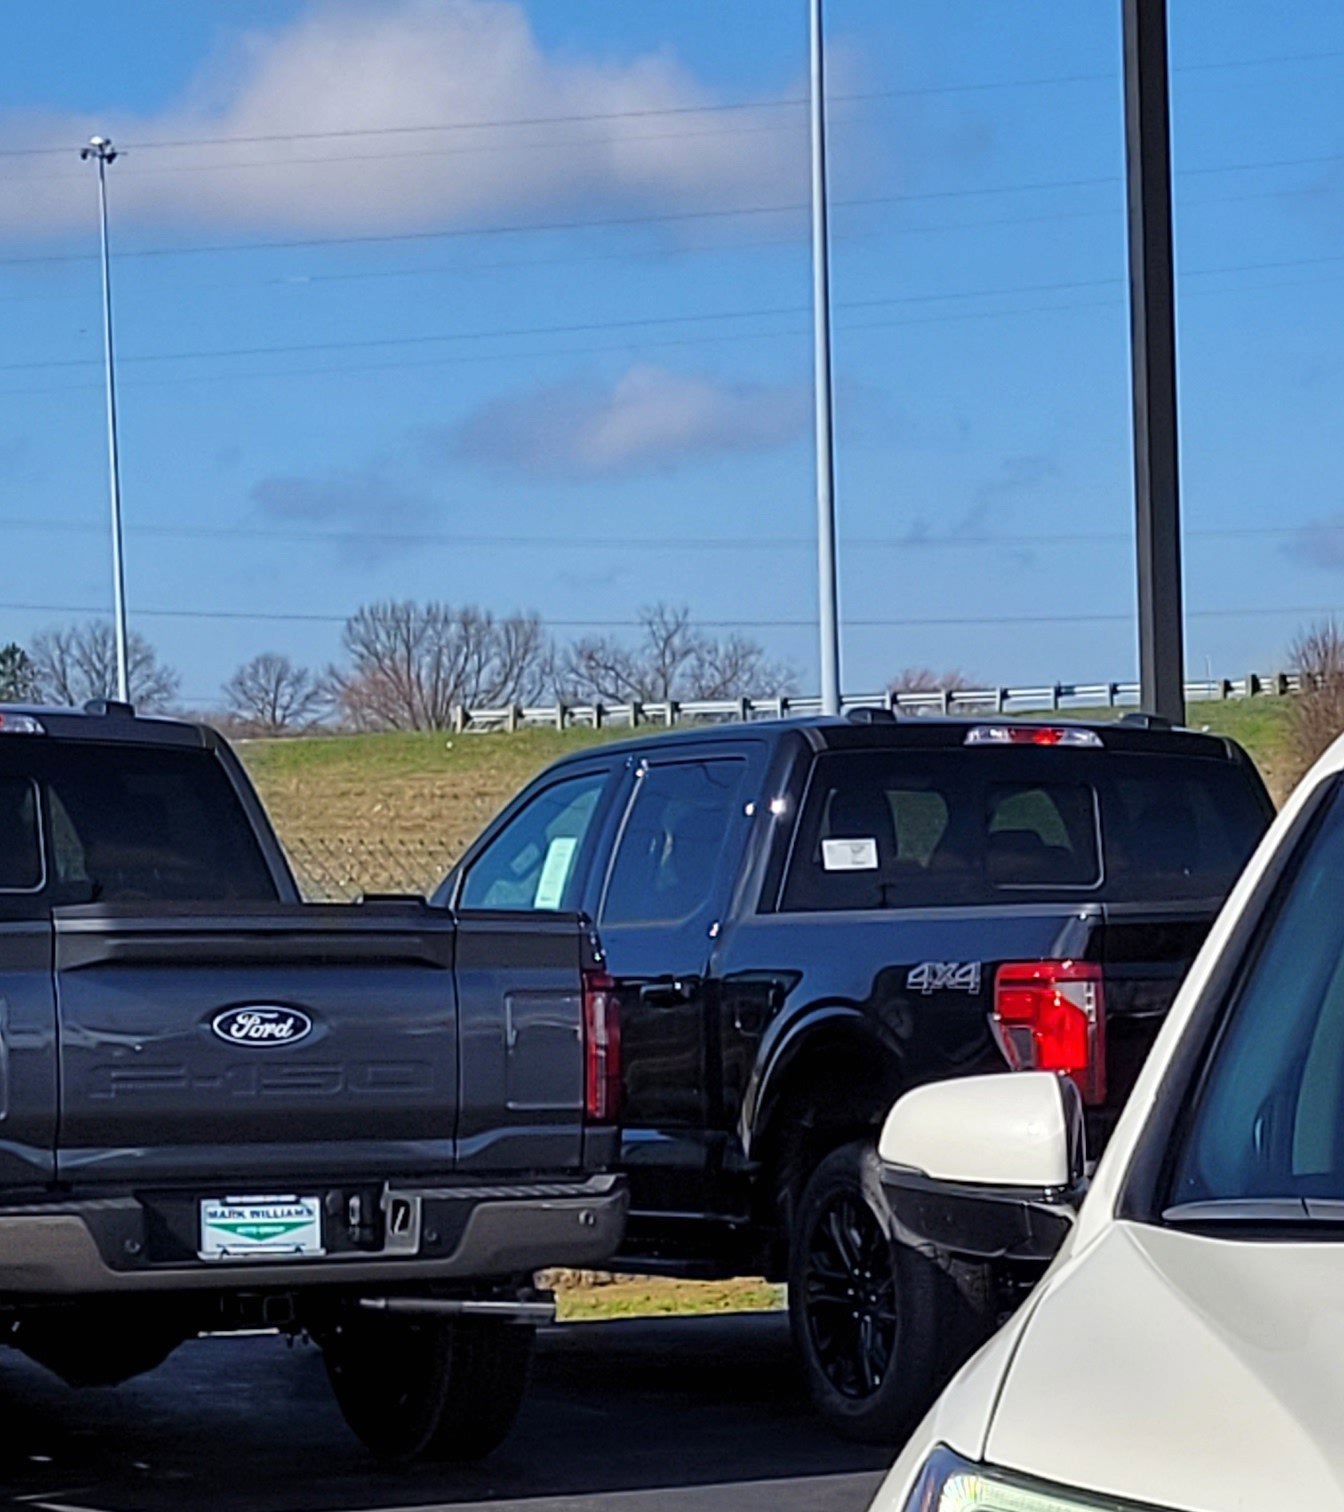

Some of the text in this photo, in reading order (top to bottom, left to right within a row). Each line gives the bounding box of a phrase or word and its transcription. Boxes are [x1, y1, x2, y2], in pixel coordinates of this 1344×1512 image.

[230, 1011, 295, 1039] Ford
[89, 1060, 434, 1098] F-150
[208, 1207, 314, 1219] MARK WILLIAMS
